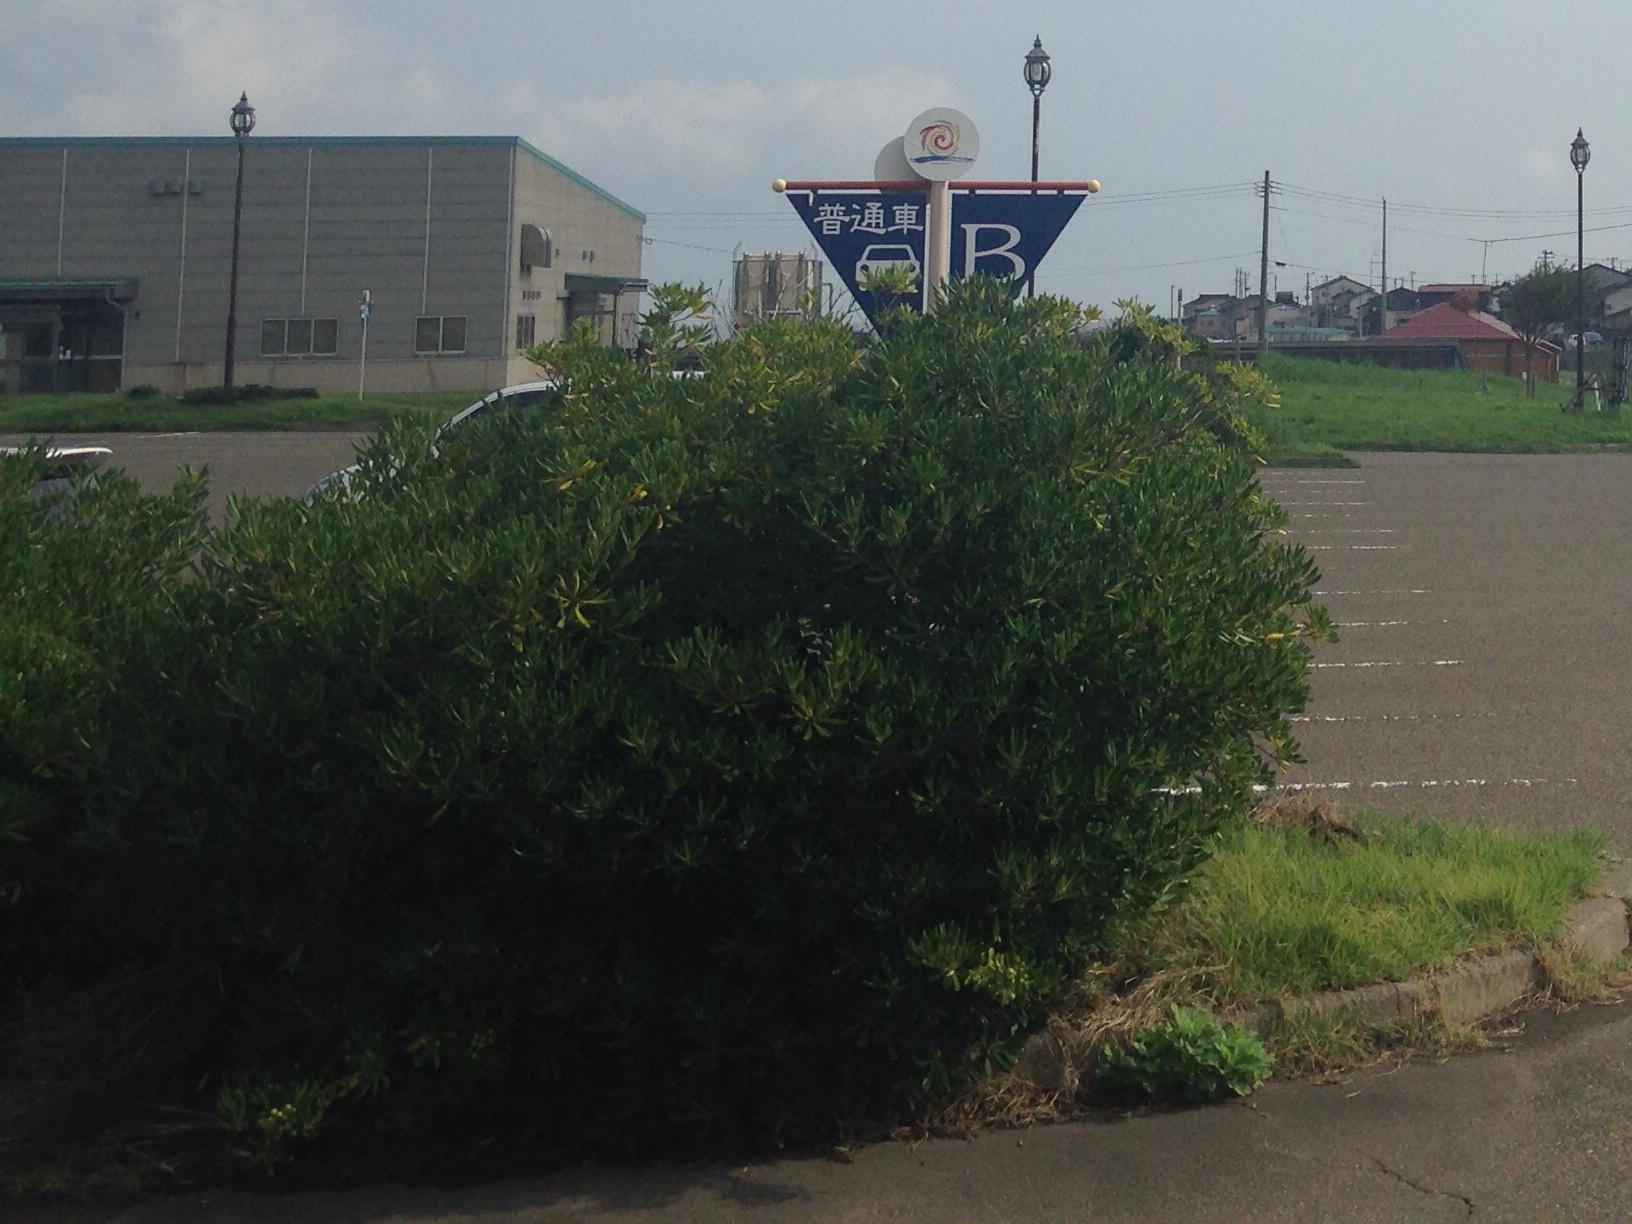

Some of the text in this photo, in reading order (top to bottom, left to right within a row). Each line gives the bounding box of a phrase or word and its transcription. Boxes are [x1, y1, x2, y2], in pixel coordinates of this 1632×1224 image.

[813, 202, 924, 235] 普通車
[960, 223, 1026, 281] B
